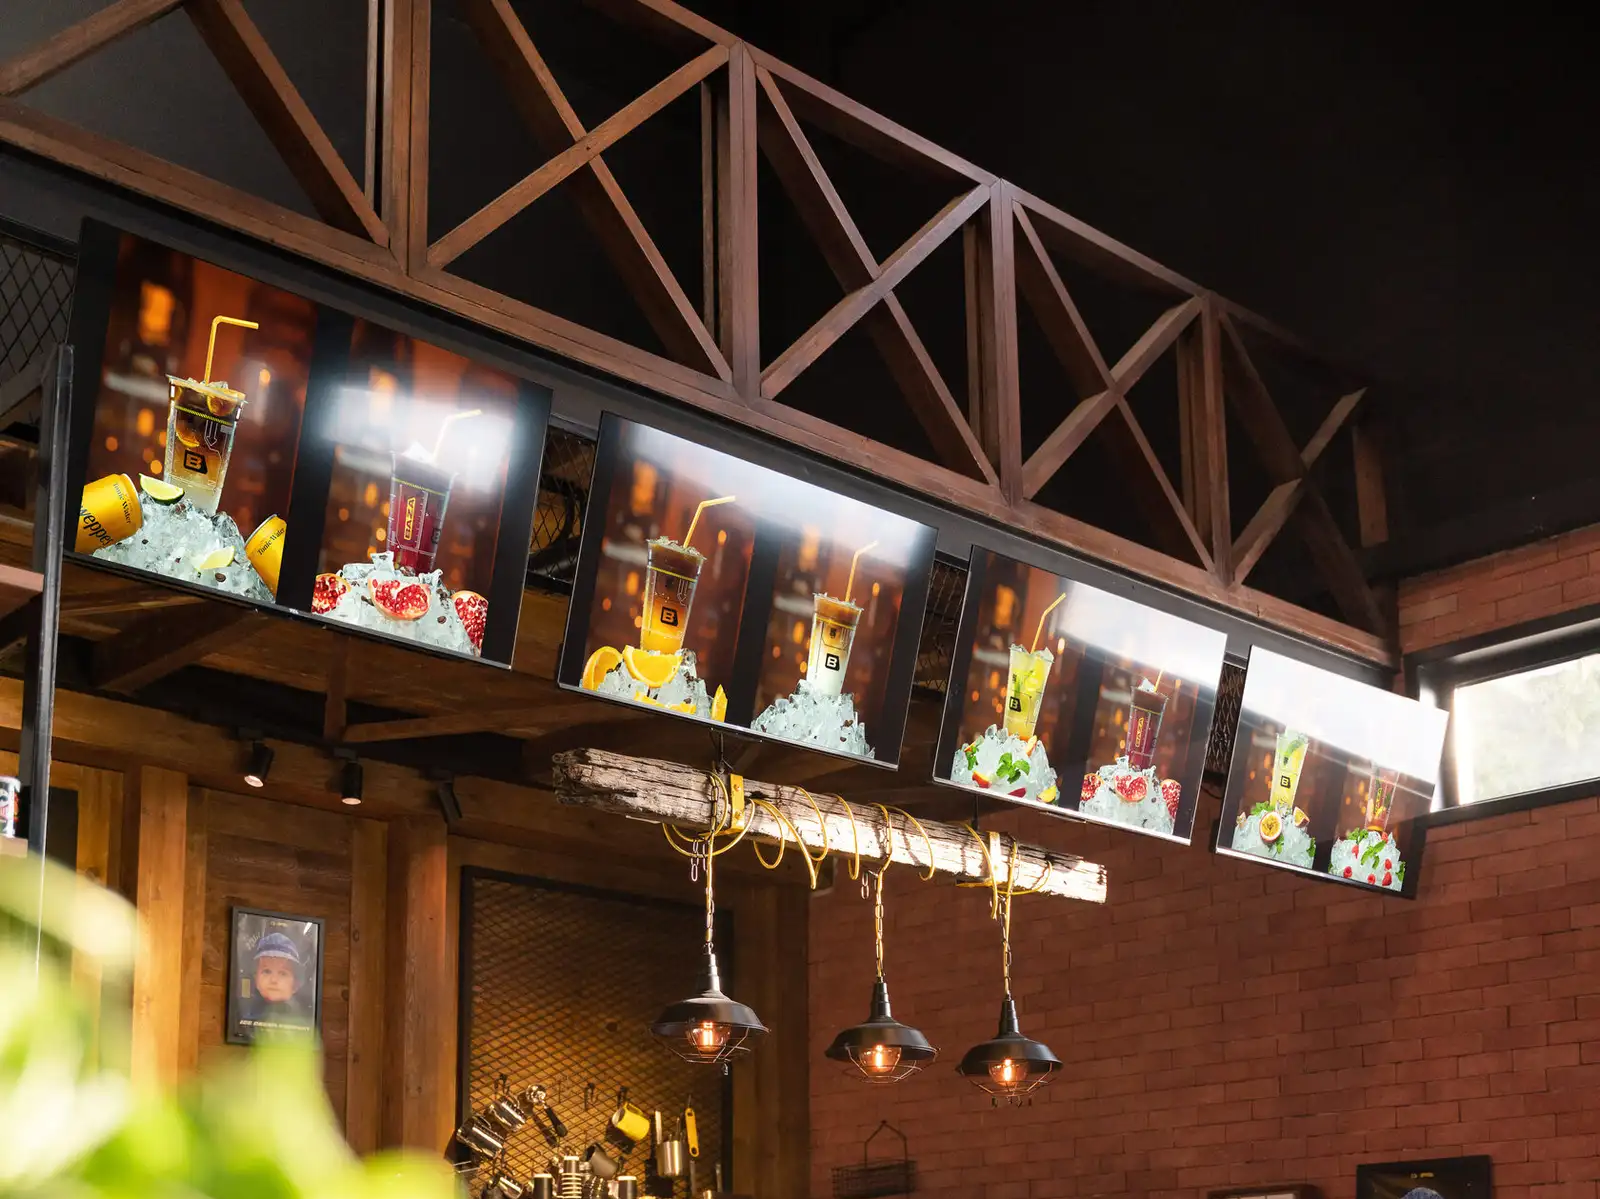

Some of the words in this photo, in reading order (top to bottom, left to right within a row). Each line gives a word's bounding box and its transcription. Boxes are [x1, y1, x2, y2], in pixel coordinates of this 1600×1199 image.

[122, 501, 133, 524] Water
[403, 498, 416, 540] BAZA
[257, 541, 272, 555] Tonic
[825, 655, 838, 669] B
